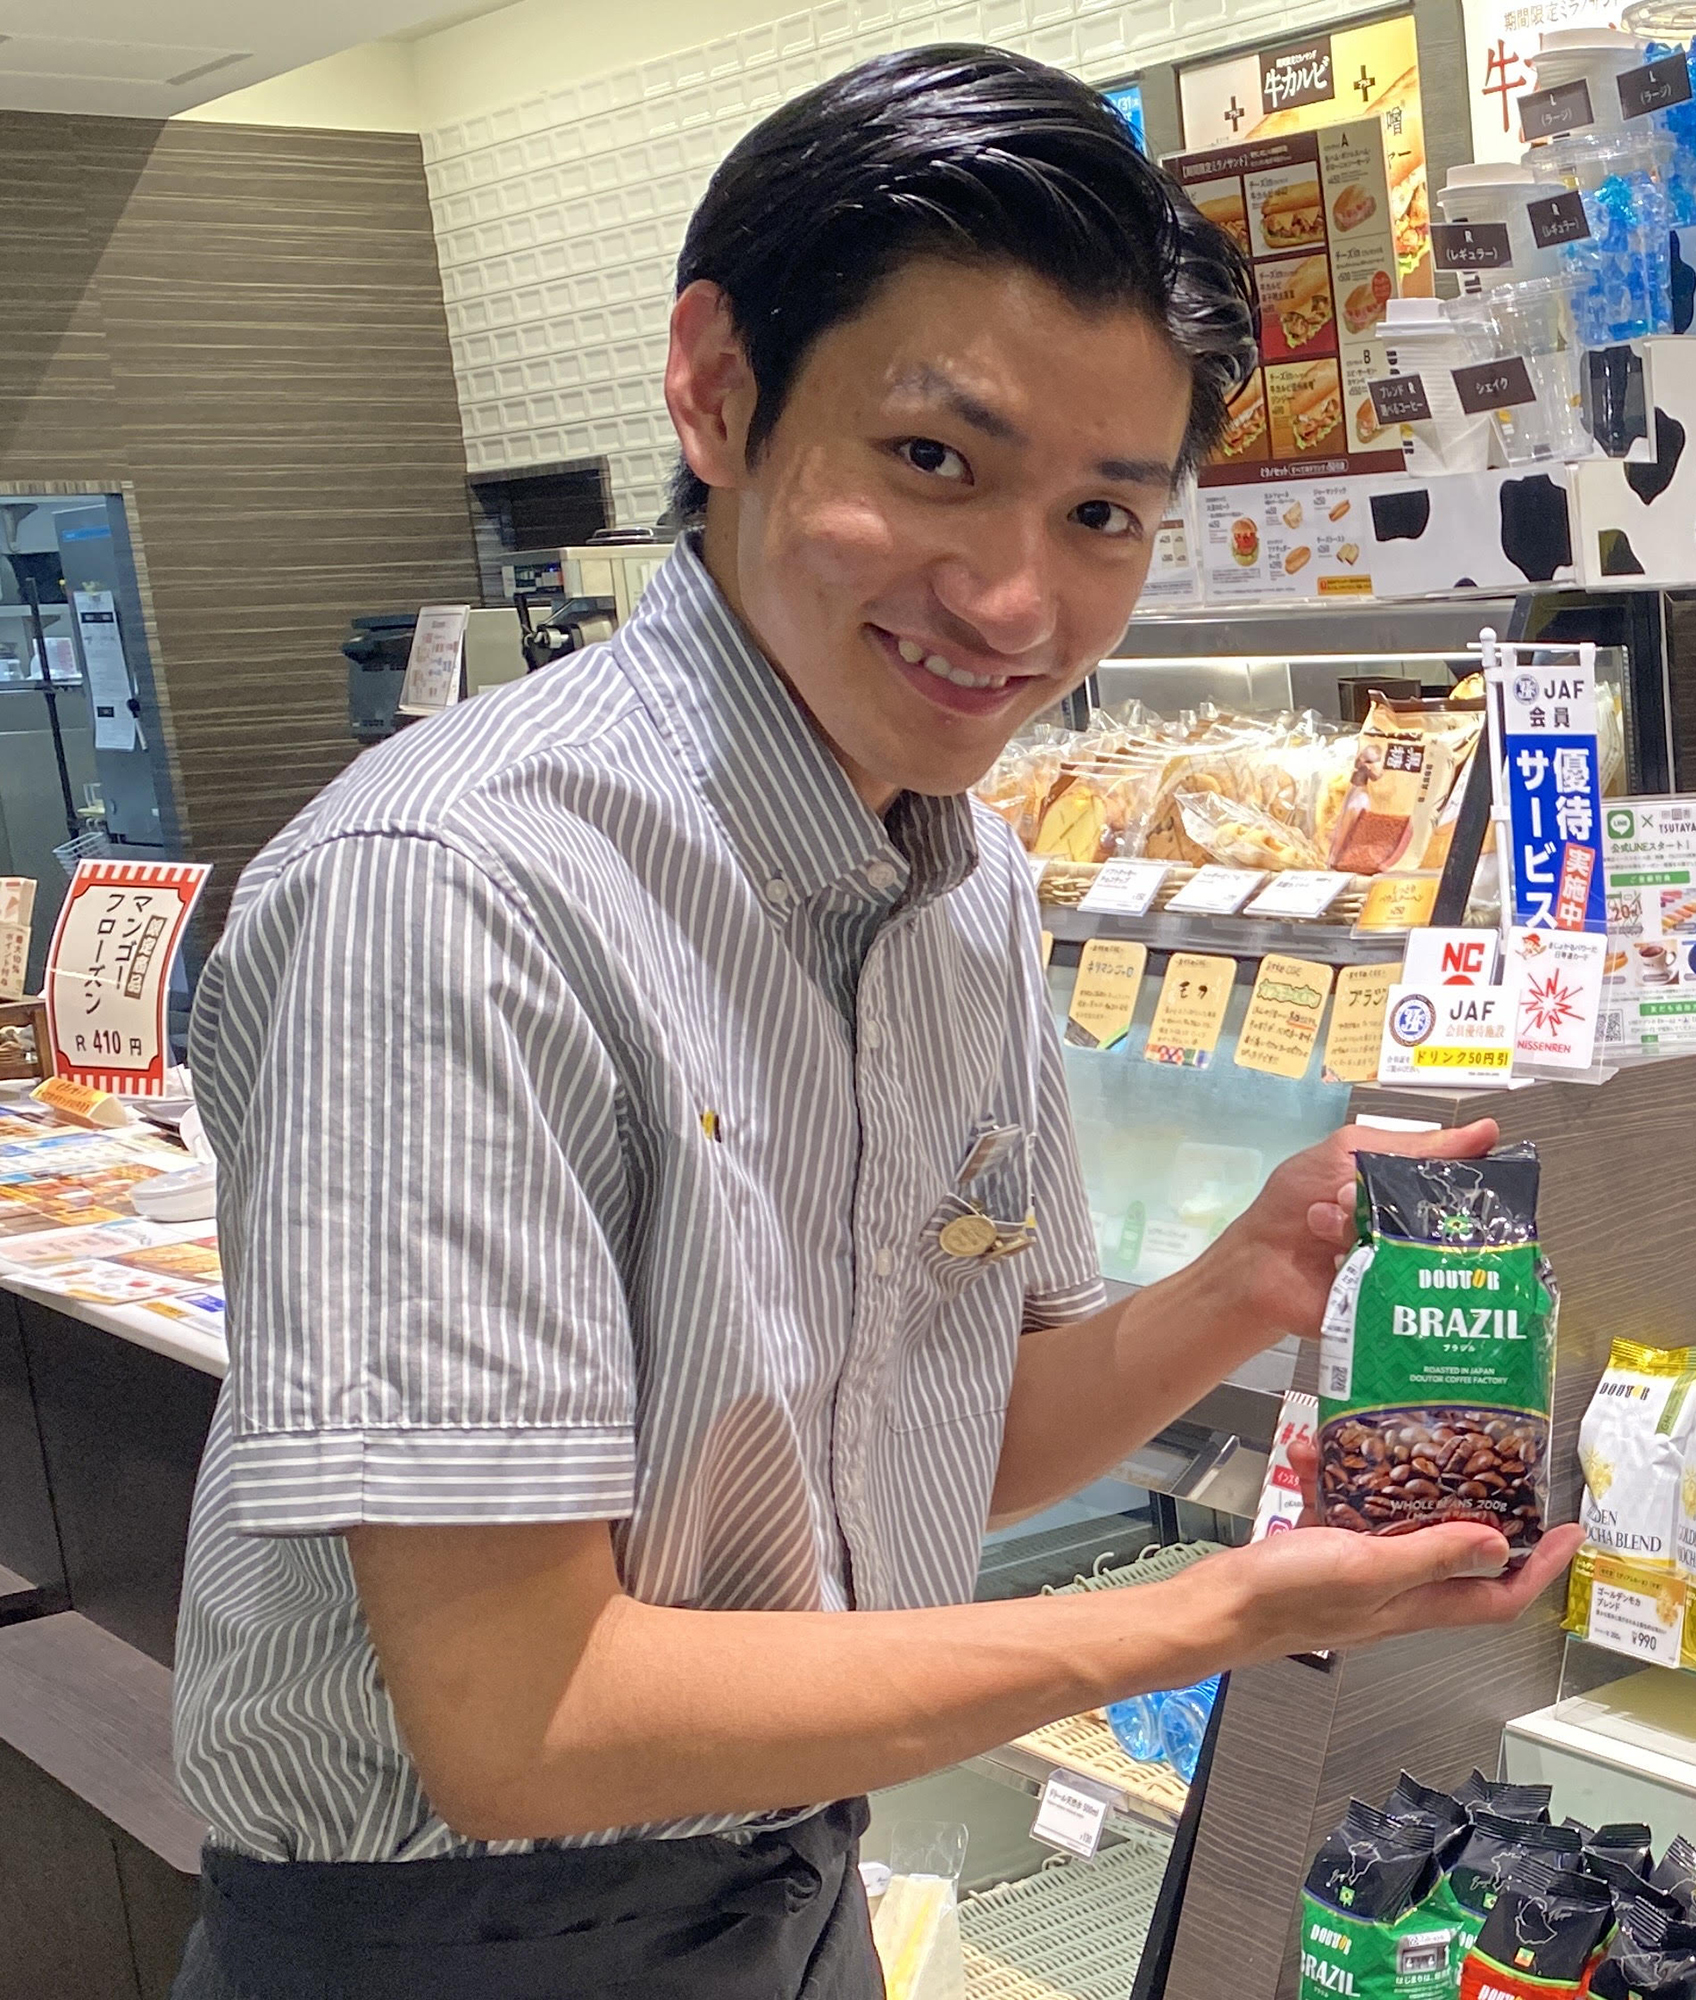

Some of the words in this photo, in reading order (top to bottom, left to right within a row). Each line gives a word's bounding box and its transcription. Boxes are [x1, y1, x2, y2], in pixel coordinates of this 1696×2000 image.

[1504, 0, 1618, 31] 期間限定ミラノ
[1264, 55, 1330, 108] 牛カルビ
[1340, 132, 1349, 147] A
[1551, 203, 1560, 216] R
[1465, 230, 1474, 243] R
[1446, 246, 1498, 261] (レギュラー)
[1363, 349, 1372, 364] B
[1379, 384, 1404, 399] ブレンド
[1475, 376, 1511, 396] シェイク
[1543, 679, 1585, 700] JAF
[1529, 706, 1571, 729] 会員
[1553, 747, 1593, 841] 優待
[1516, 749, 1559, 929] サービス
[1560, 848, 1592, 927] 実施中
[115, 894, 154, 991] マンゴー
[1441, 942, 1486, 973] NC
[1348, 987, 1387, 1007] ブラジ
[1449, 999, 1496, 1021] JAF
[75, 1034, 87, 1052] R
[93, 1029, 121, 1055] 410
[129, 1037, 142, 1056] 円
[1418, 1268, 1501, 1291] DOUTOR
[1392, 1304, 1528, 1340] BRAZIL
[1616, 1531, 1662, 1553] BLEND
[1597, 1597, 1621, 1612] ブレンド
